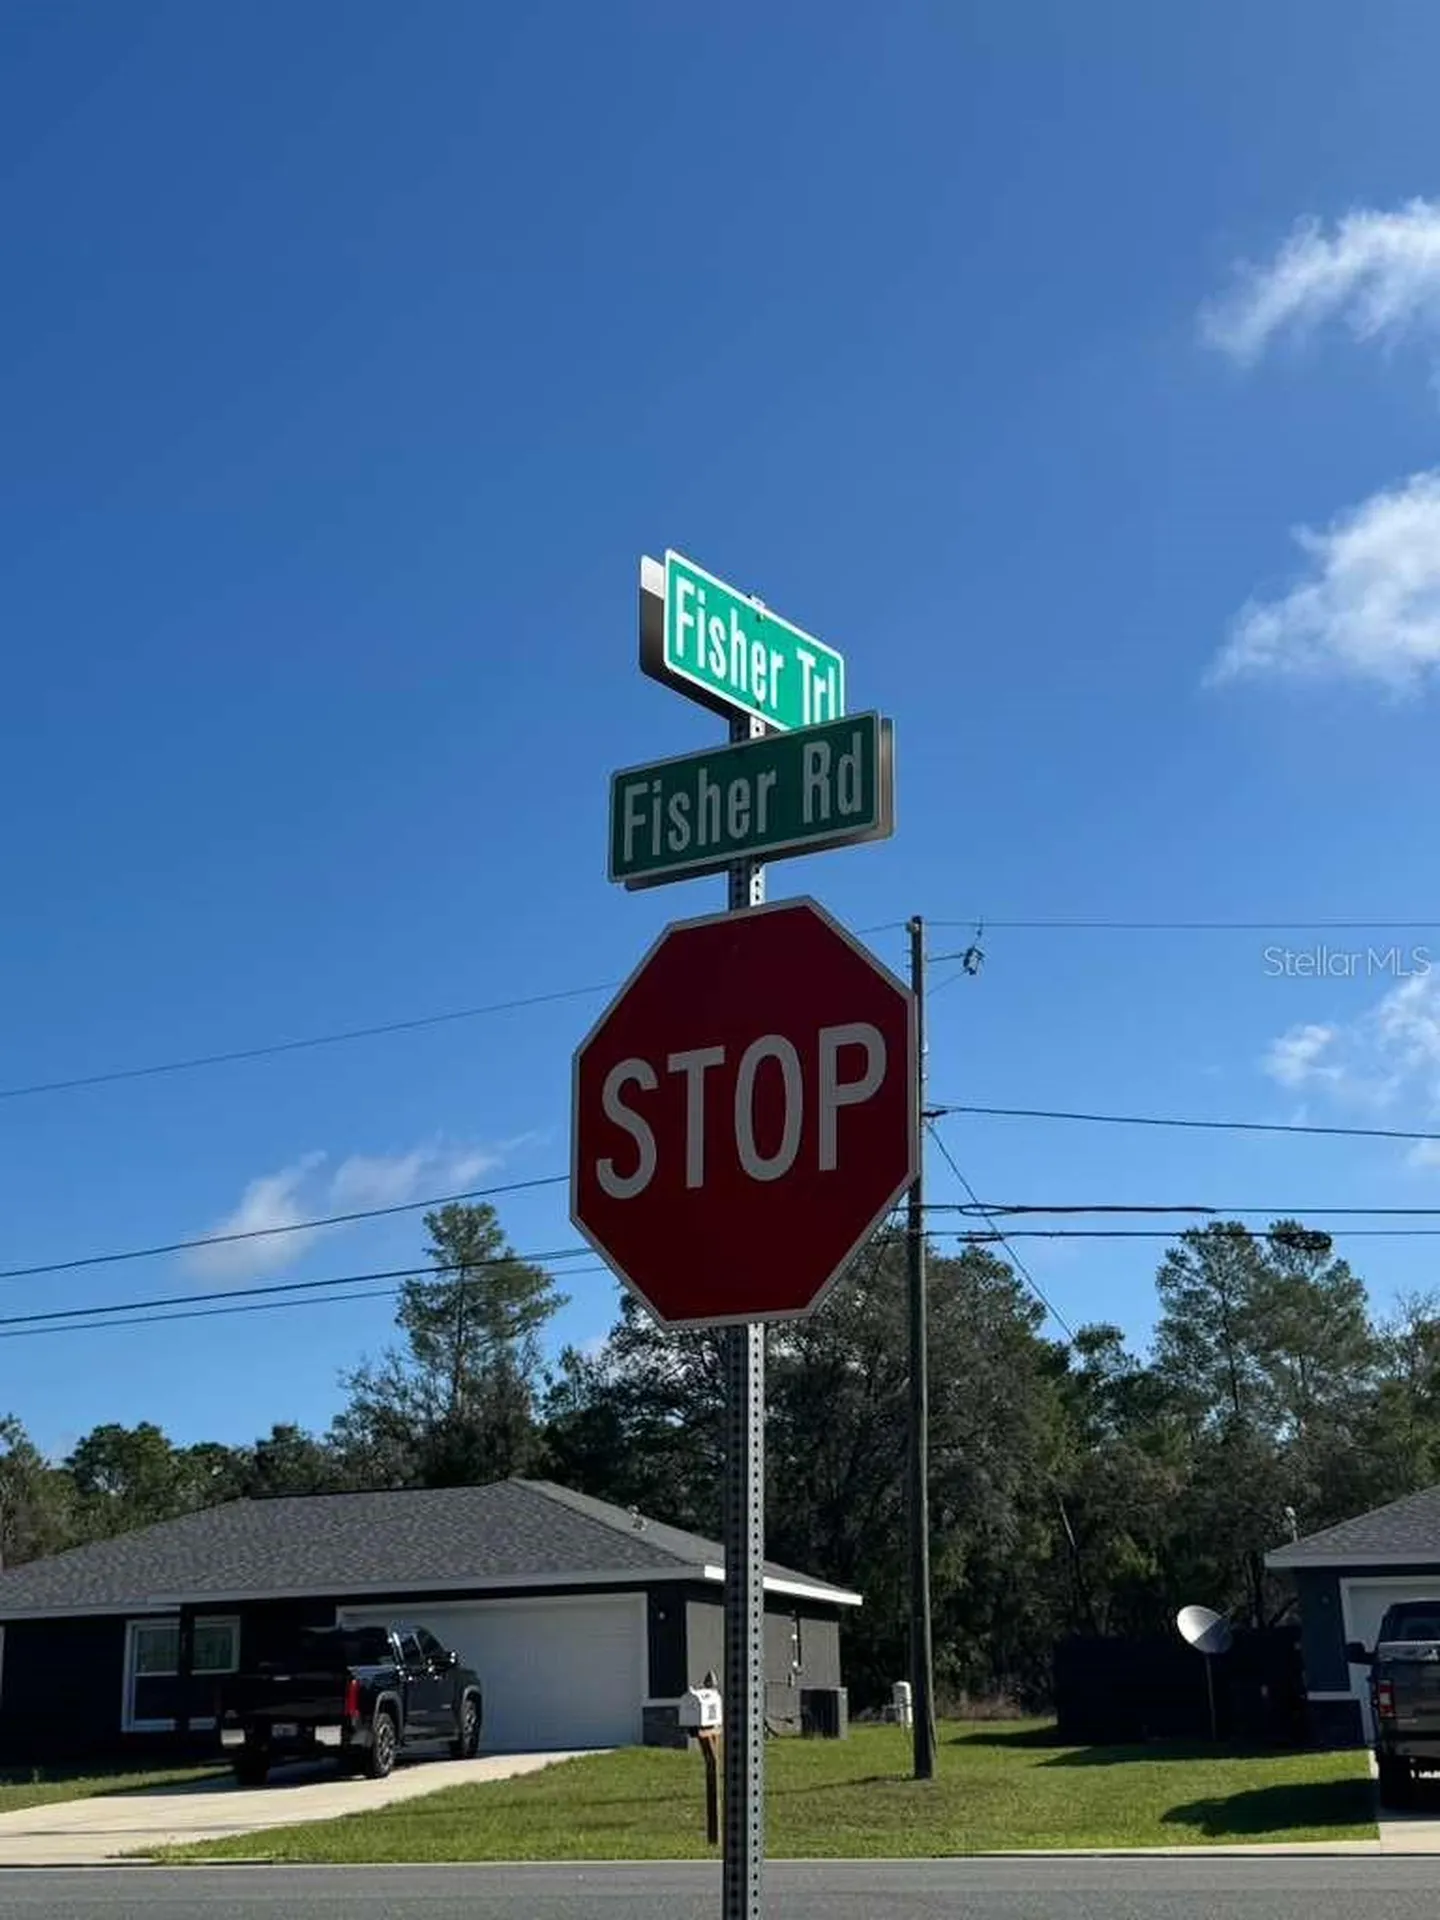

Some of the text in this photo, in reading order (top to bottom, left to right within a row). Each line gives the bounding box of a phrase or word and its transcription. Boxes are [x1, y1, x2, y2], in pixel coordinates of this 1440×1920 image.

[674, 574, 836, 730] Fisher Trl
[622, 731, 863, 862] Fisher Rd
[596, 1021, 887, 1200] STOP
